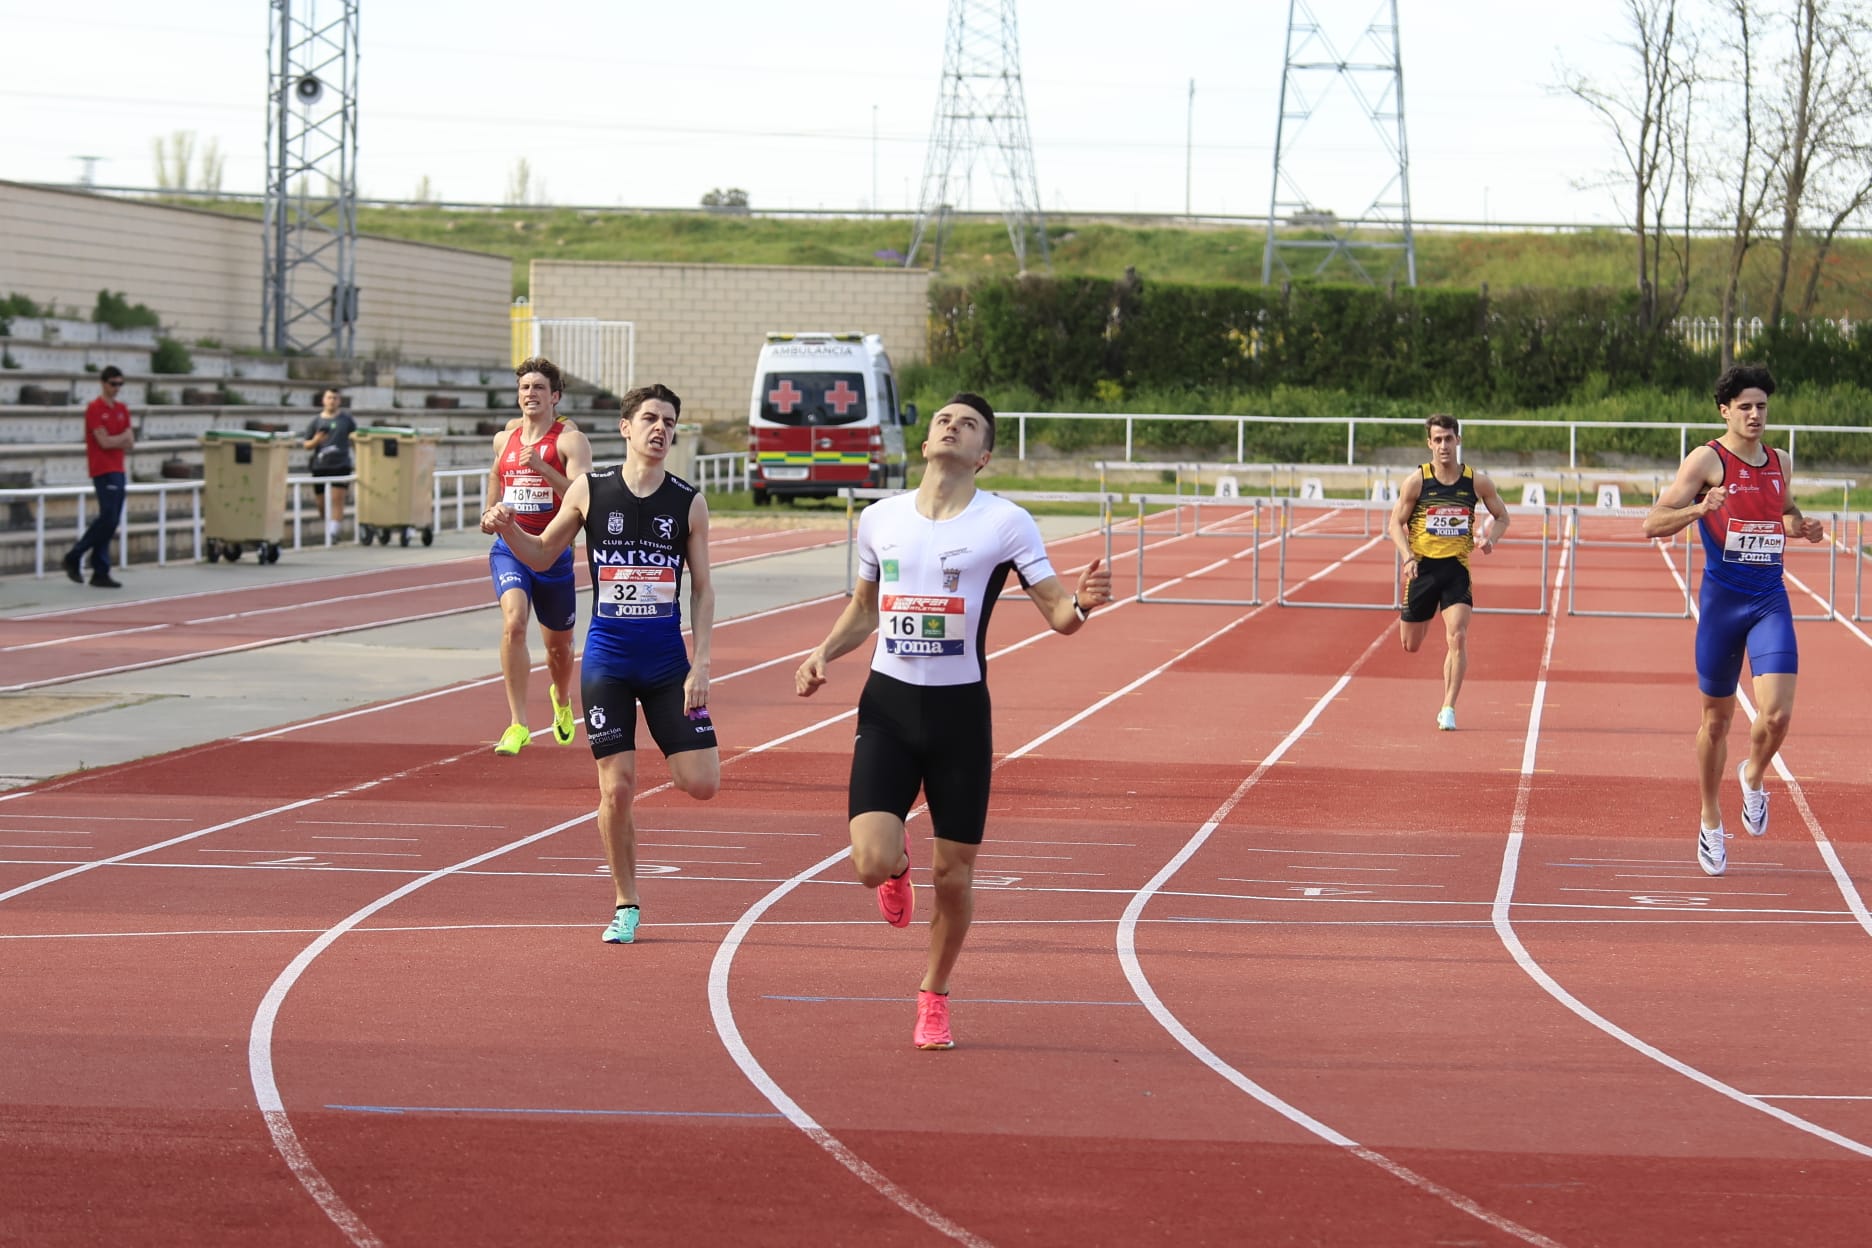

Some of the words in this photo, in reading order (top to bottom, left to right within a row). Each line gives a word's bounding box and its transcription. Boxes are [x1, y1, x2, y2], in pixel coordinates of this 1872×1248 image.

[771, 346, 853, 355] AMBULANCIA
[513, 489, 524, 501] 18
[531, 490, 550, 498] ADM
[1223, 484, 1231, 497] 8
[1308, 484, 1316, 498] 7
[1529, 490, 1538, 505] 4
[1605, 492, 1613, 508] 3
[1433, 517, 1447, 527] 25
[1738, 536, 1757, 549] 17
[1764, 539, 1781, 547] ADM
[613, 584, 637, 601] 32
[890, 615, 915, 636] 16
